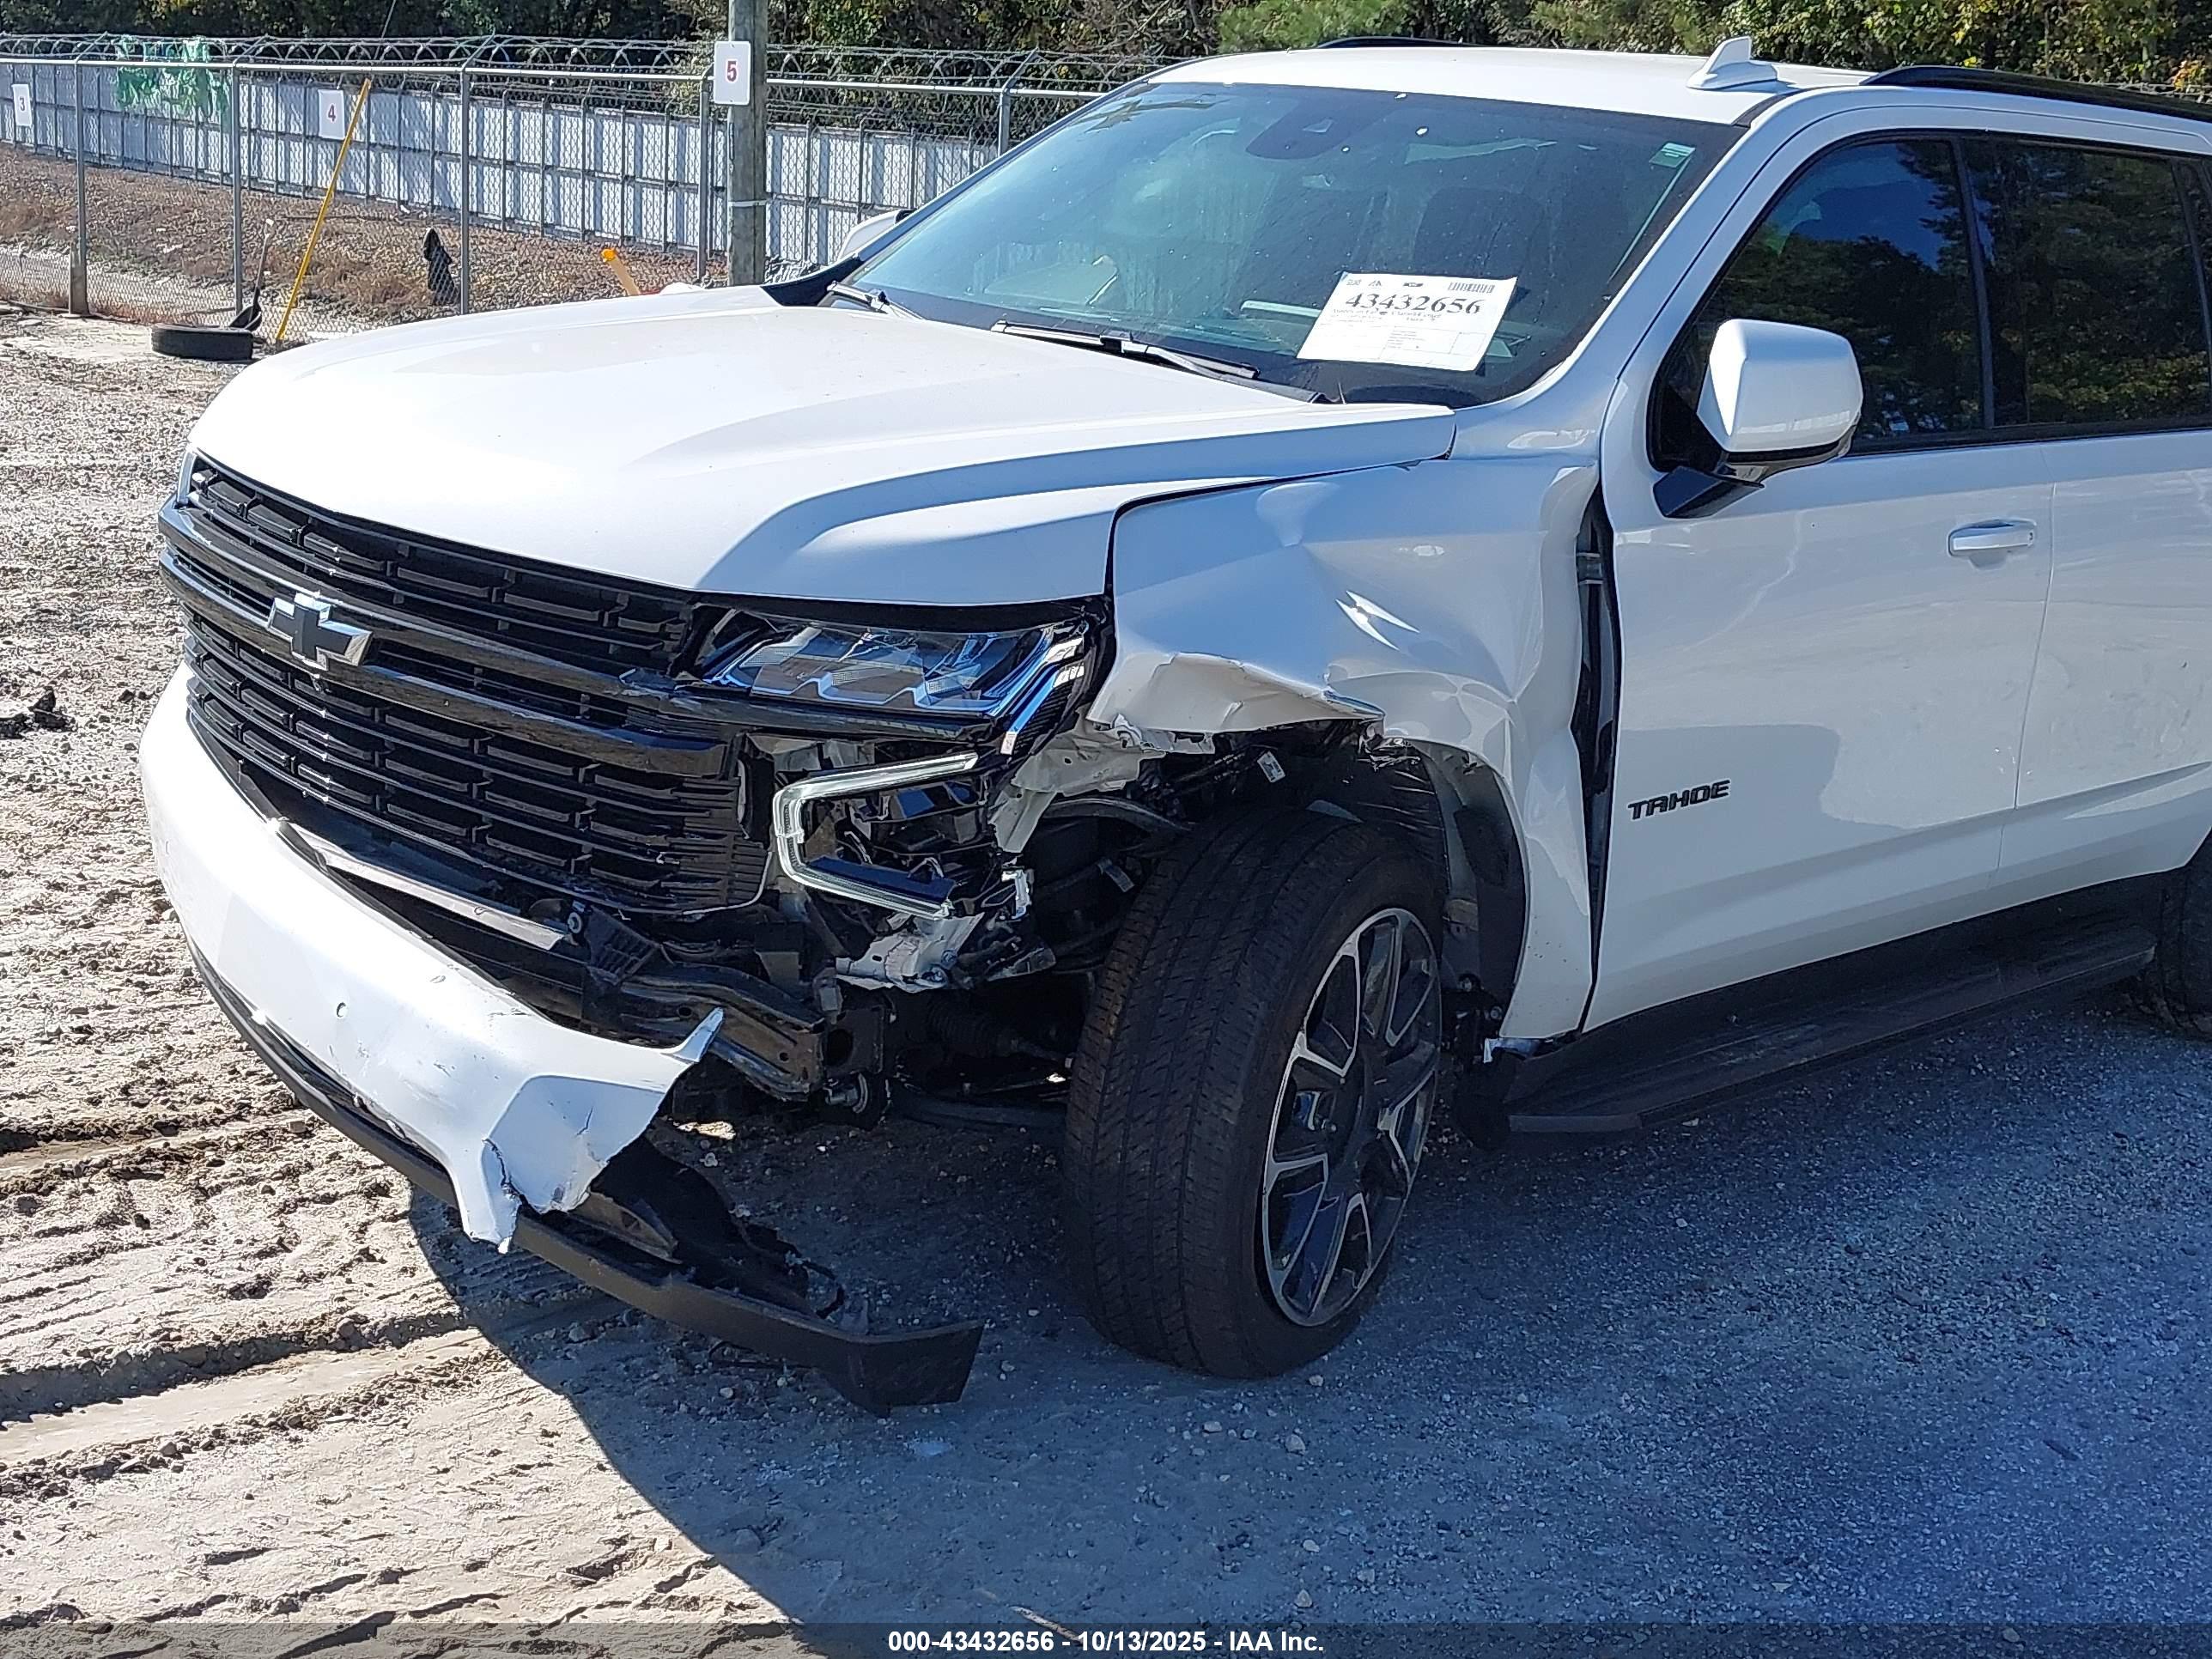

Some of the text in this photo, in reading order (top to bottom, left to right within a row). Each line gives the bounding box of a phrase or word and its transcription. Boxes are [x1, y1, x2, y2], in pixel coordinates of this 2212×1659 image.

[726, 60, 738, 82] 5
[19, 96, 26, 112] 3
[327, 103, 337, 122] 4
[1345, 292, 1486, 314] 43432656
[1627, 779, 1731, 820] TAHOE
